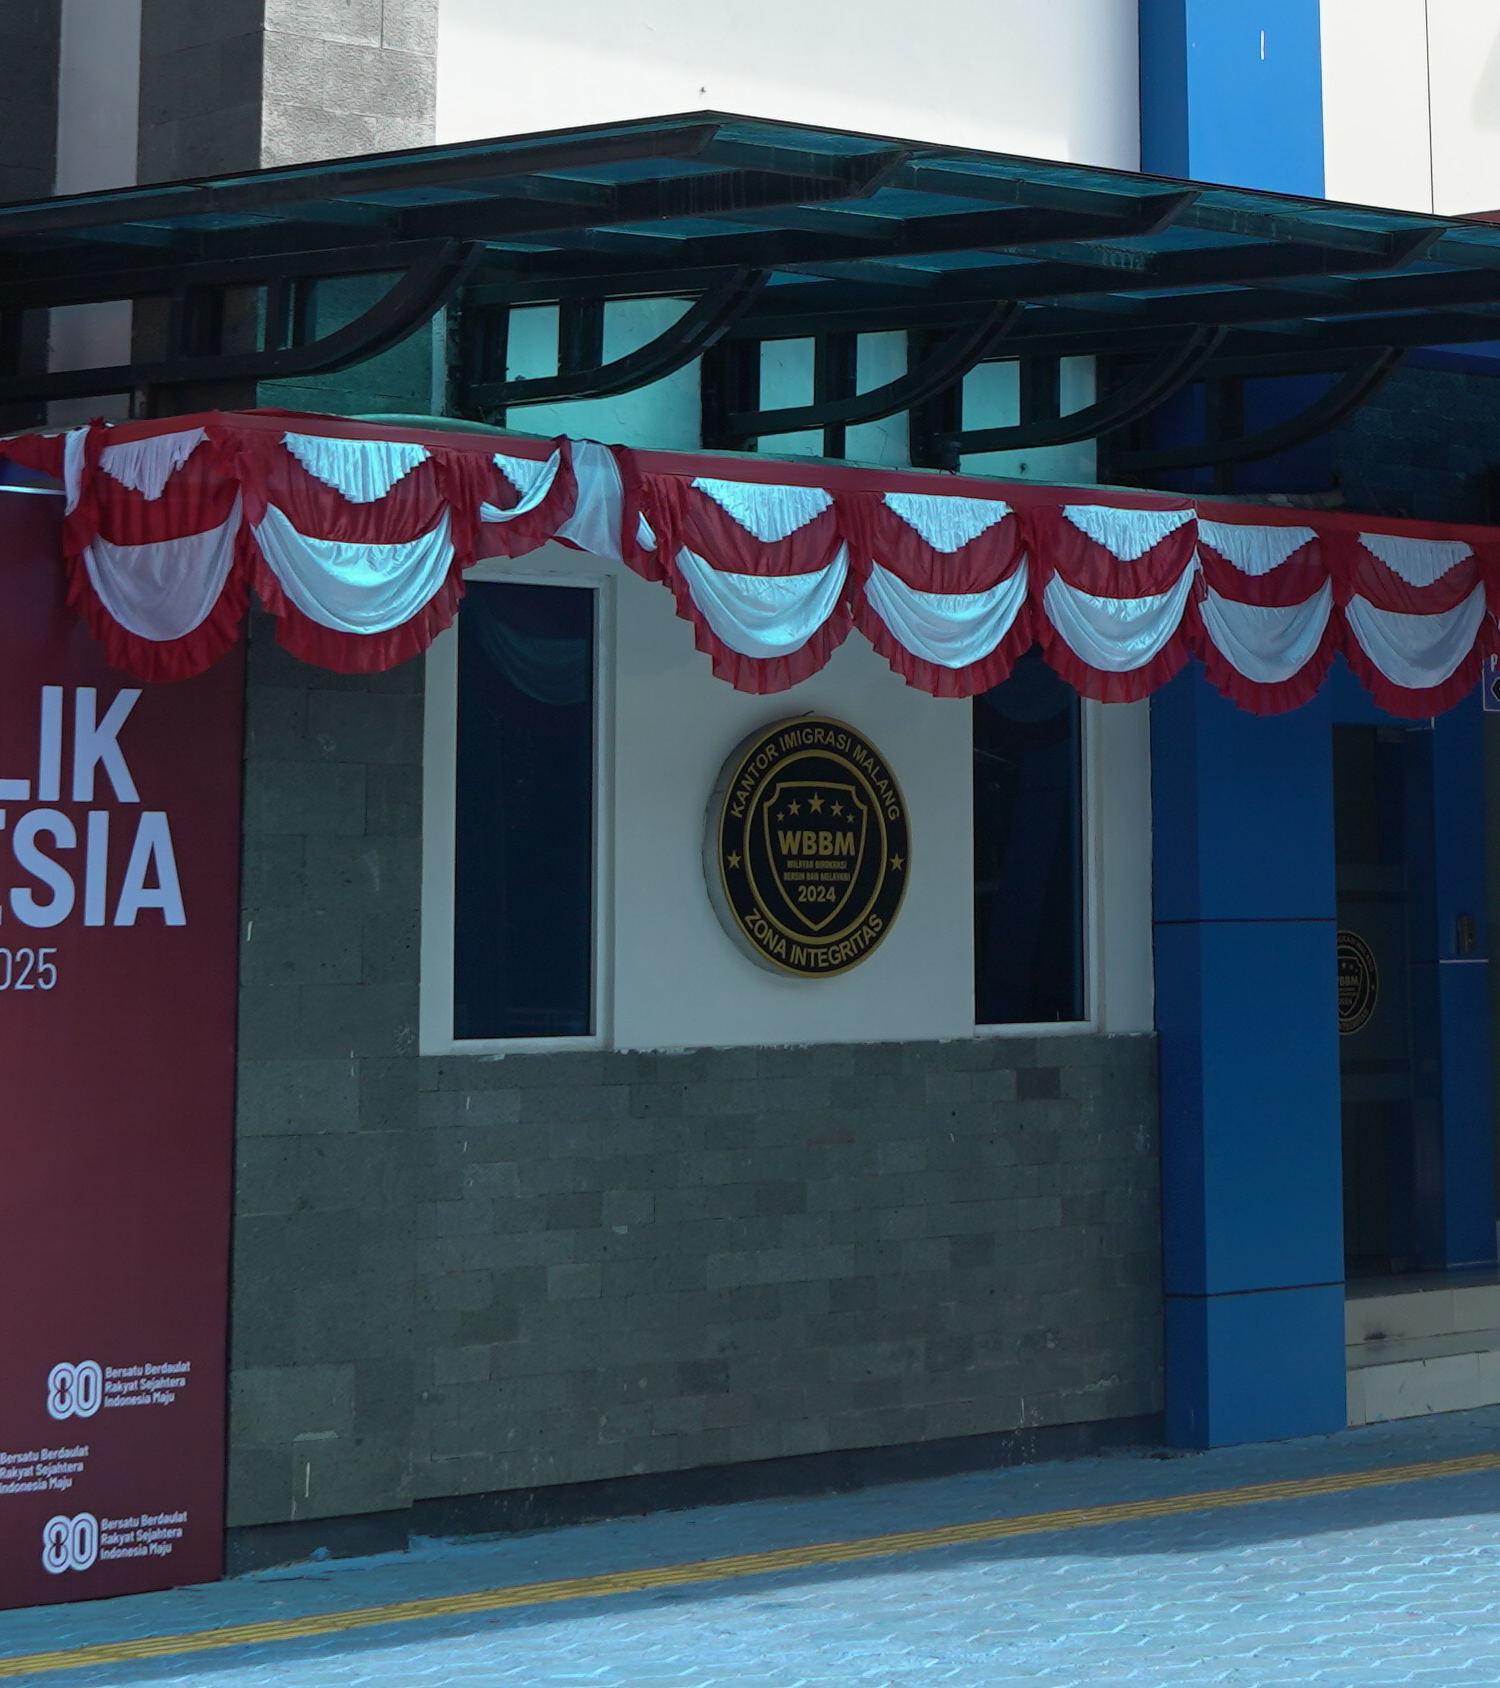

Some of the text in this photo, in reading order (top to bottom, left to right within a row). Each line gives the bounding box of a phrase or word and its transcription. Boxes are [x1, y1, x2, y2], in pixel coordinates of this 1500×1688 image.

[731, 728, 900, 821] KANTOR IMIGRASI MALANG
[777, 830, 856, 856] WBBM
[787, 860, 814, 869] WILAYAH
[798, 885, 836, 902] 2024
[744, 908, 884, 967] ZONA INTEGRITAS
[106, 1361, 190, 1378] Bersatu Berdaulat
[47, 1360, 103, 1420] 80
[105, 1377, 185, 1394] Rakyat Sejahtera
[104, 1391, 175, 1408] Indonesia Maju
